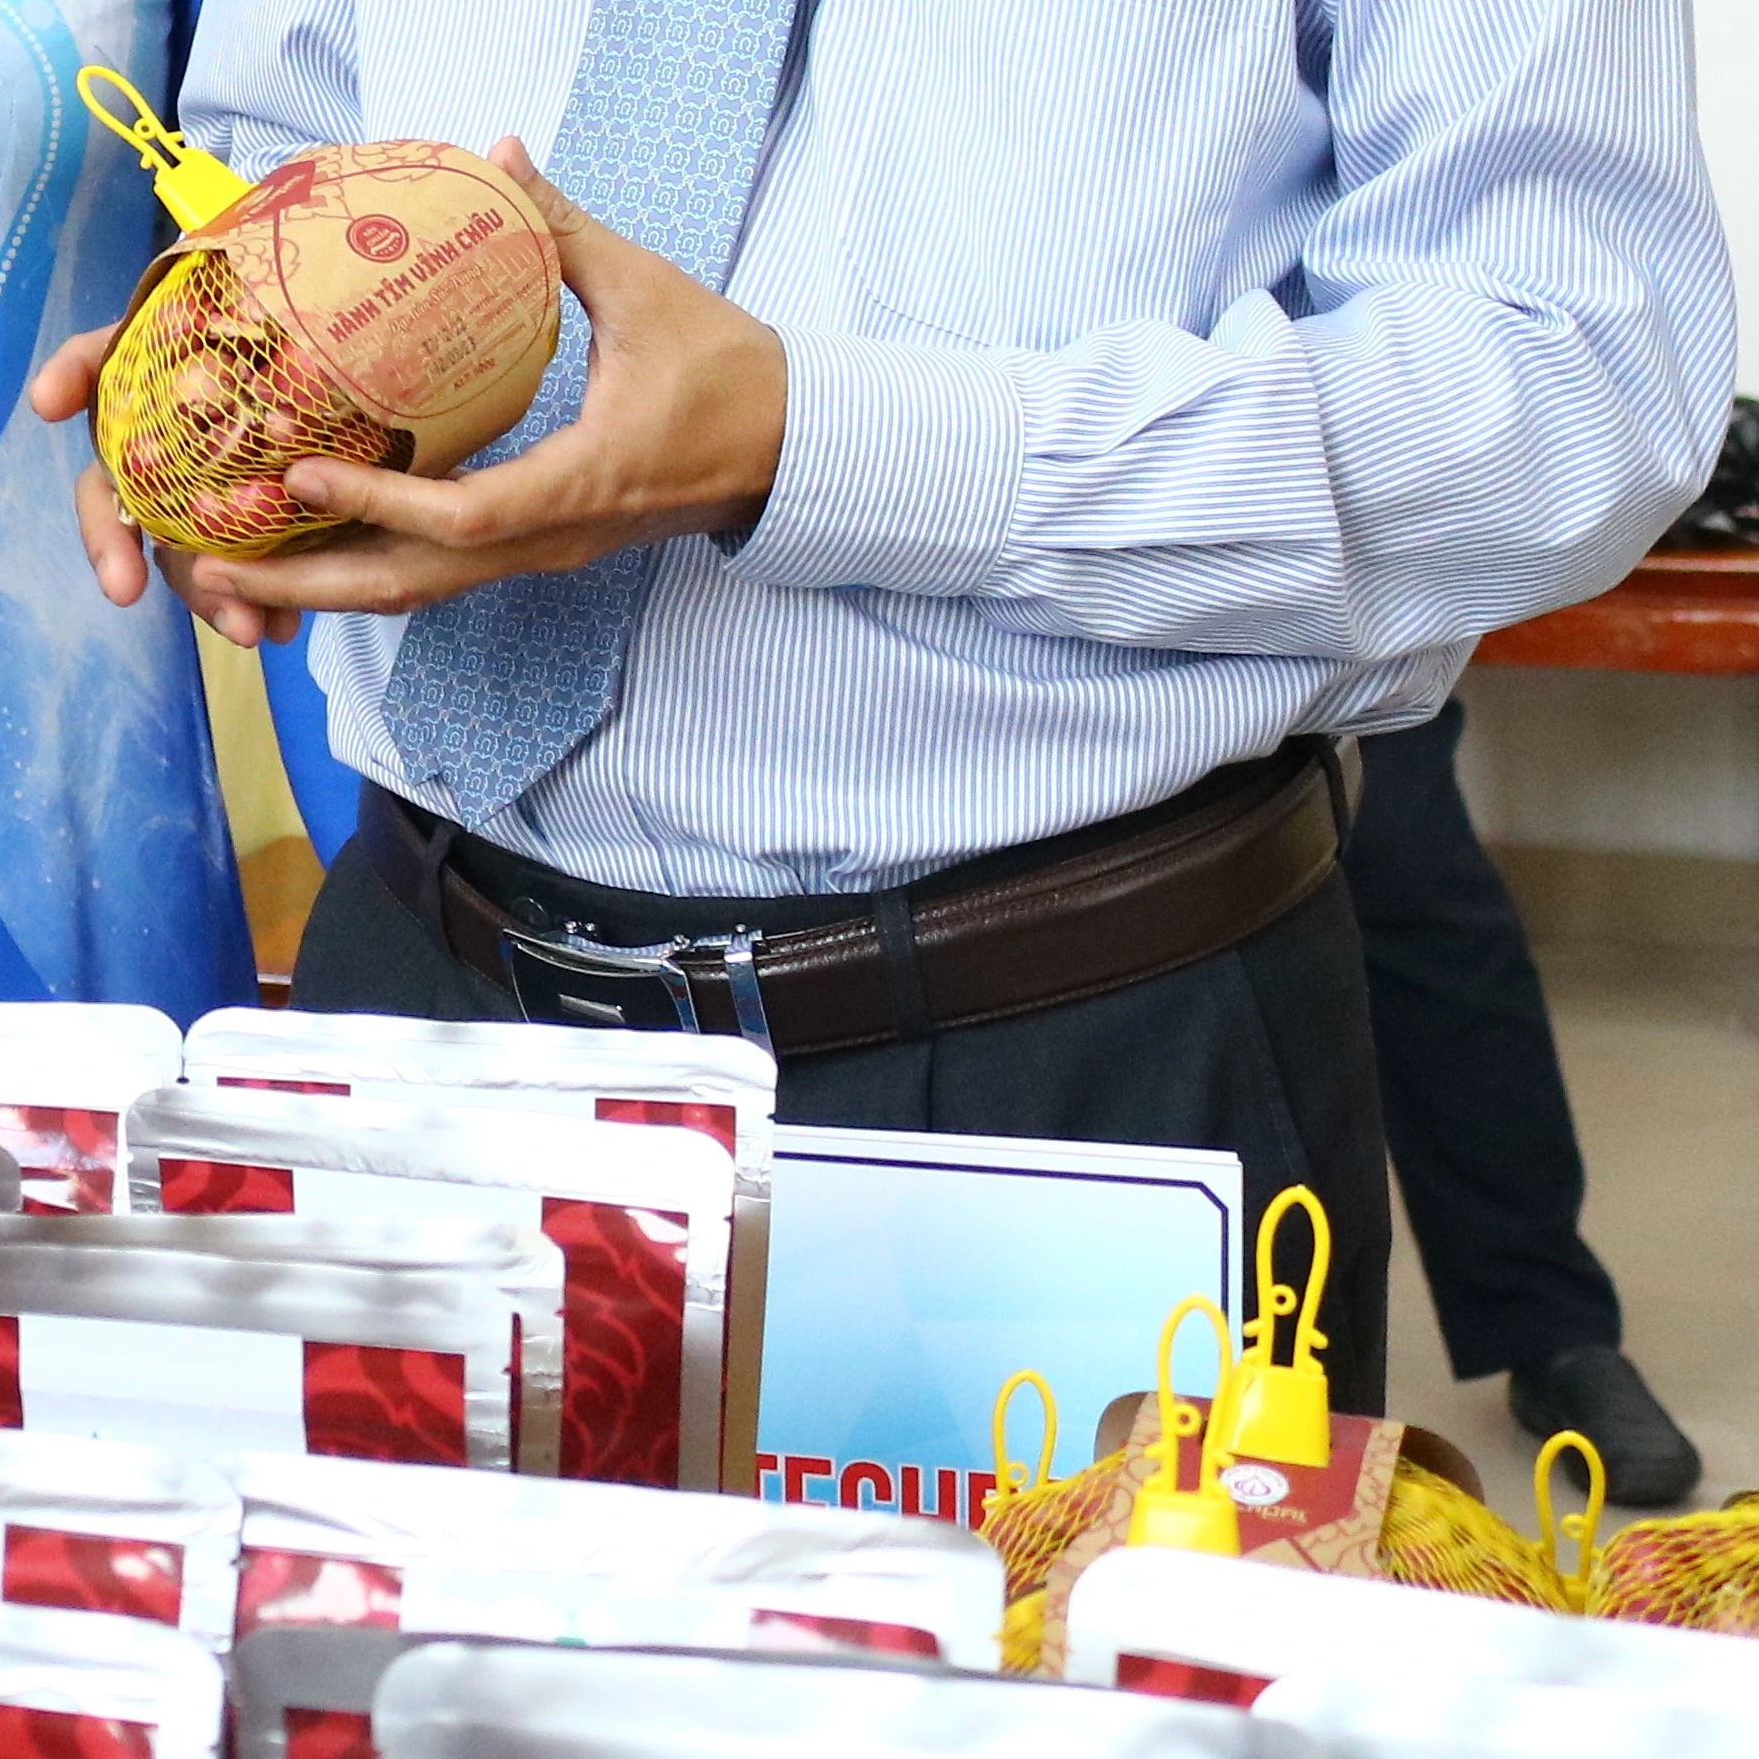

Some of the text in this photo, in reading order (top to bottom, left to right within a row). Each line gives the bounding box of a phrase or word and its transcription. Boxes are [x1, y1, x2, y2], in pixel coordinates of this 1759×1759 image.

[327, 297, 381, 344] HÀNH
[409, 241, 460, 283] VĨNH
[454, 207, 504, 251] CHÂU
